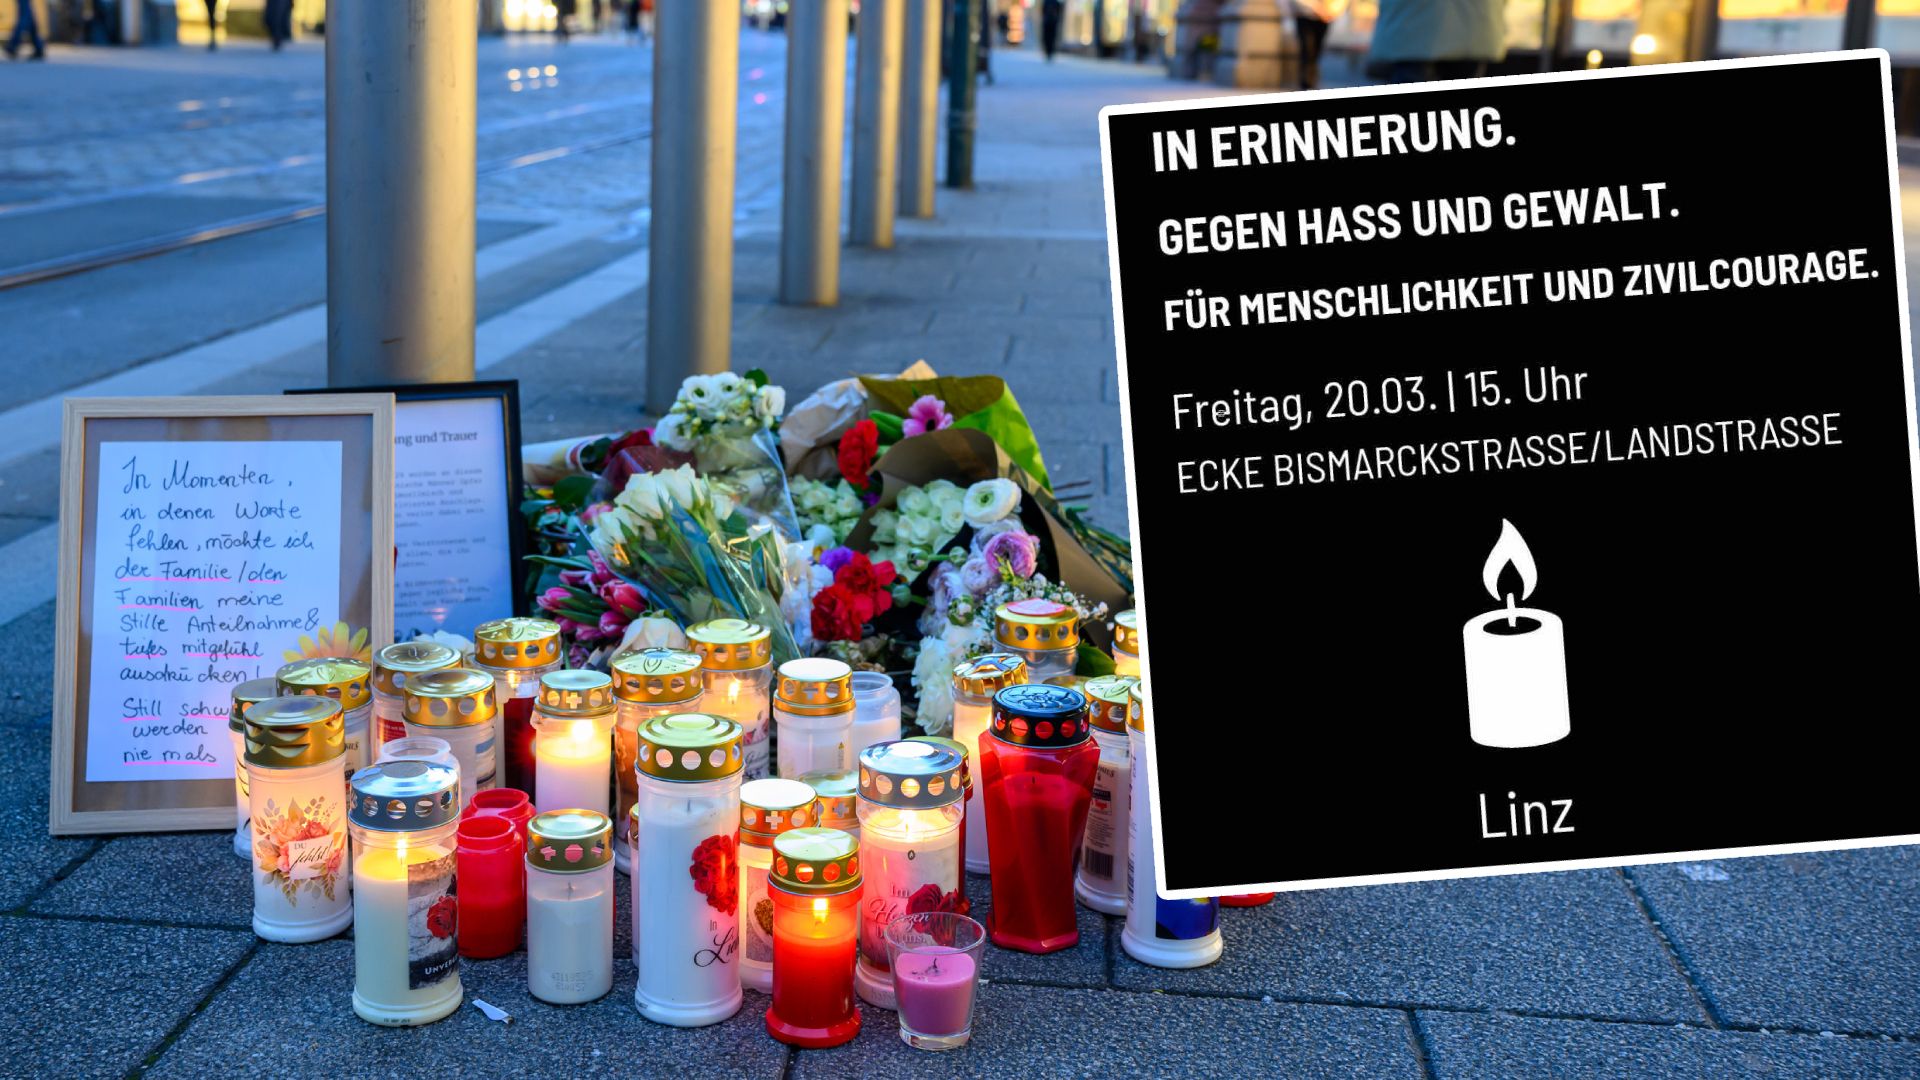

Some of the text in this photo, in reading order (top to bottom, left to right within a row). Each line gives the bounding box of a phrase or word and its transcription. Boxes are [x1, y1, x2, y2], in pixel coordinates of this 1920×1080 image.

[415, 432, 438, 444] und
[439, 431, 478, 442] Trauer
[122, 456, 151, 493] In
[120, 501, 302, 520] in denen Worte
[283, 530, 315, 550] ich
[114, 557, 151, 579] der
[114, 587, 284, 610] Familien meine
[120, 614, 169, 632] Stille
[122, 697, 161, 719] Still
[132, 718, 208, 738] werden
